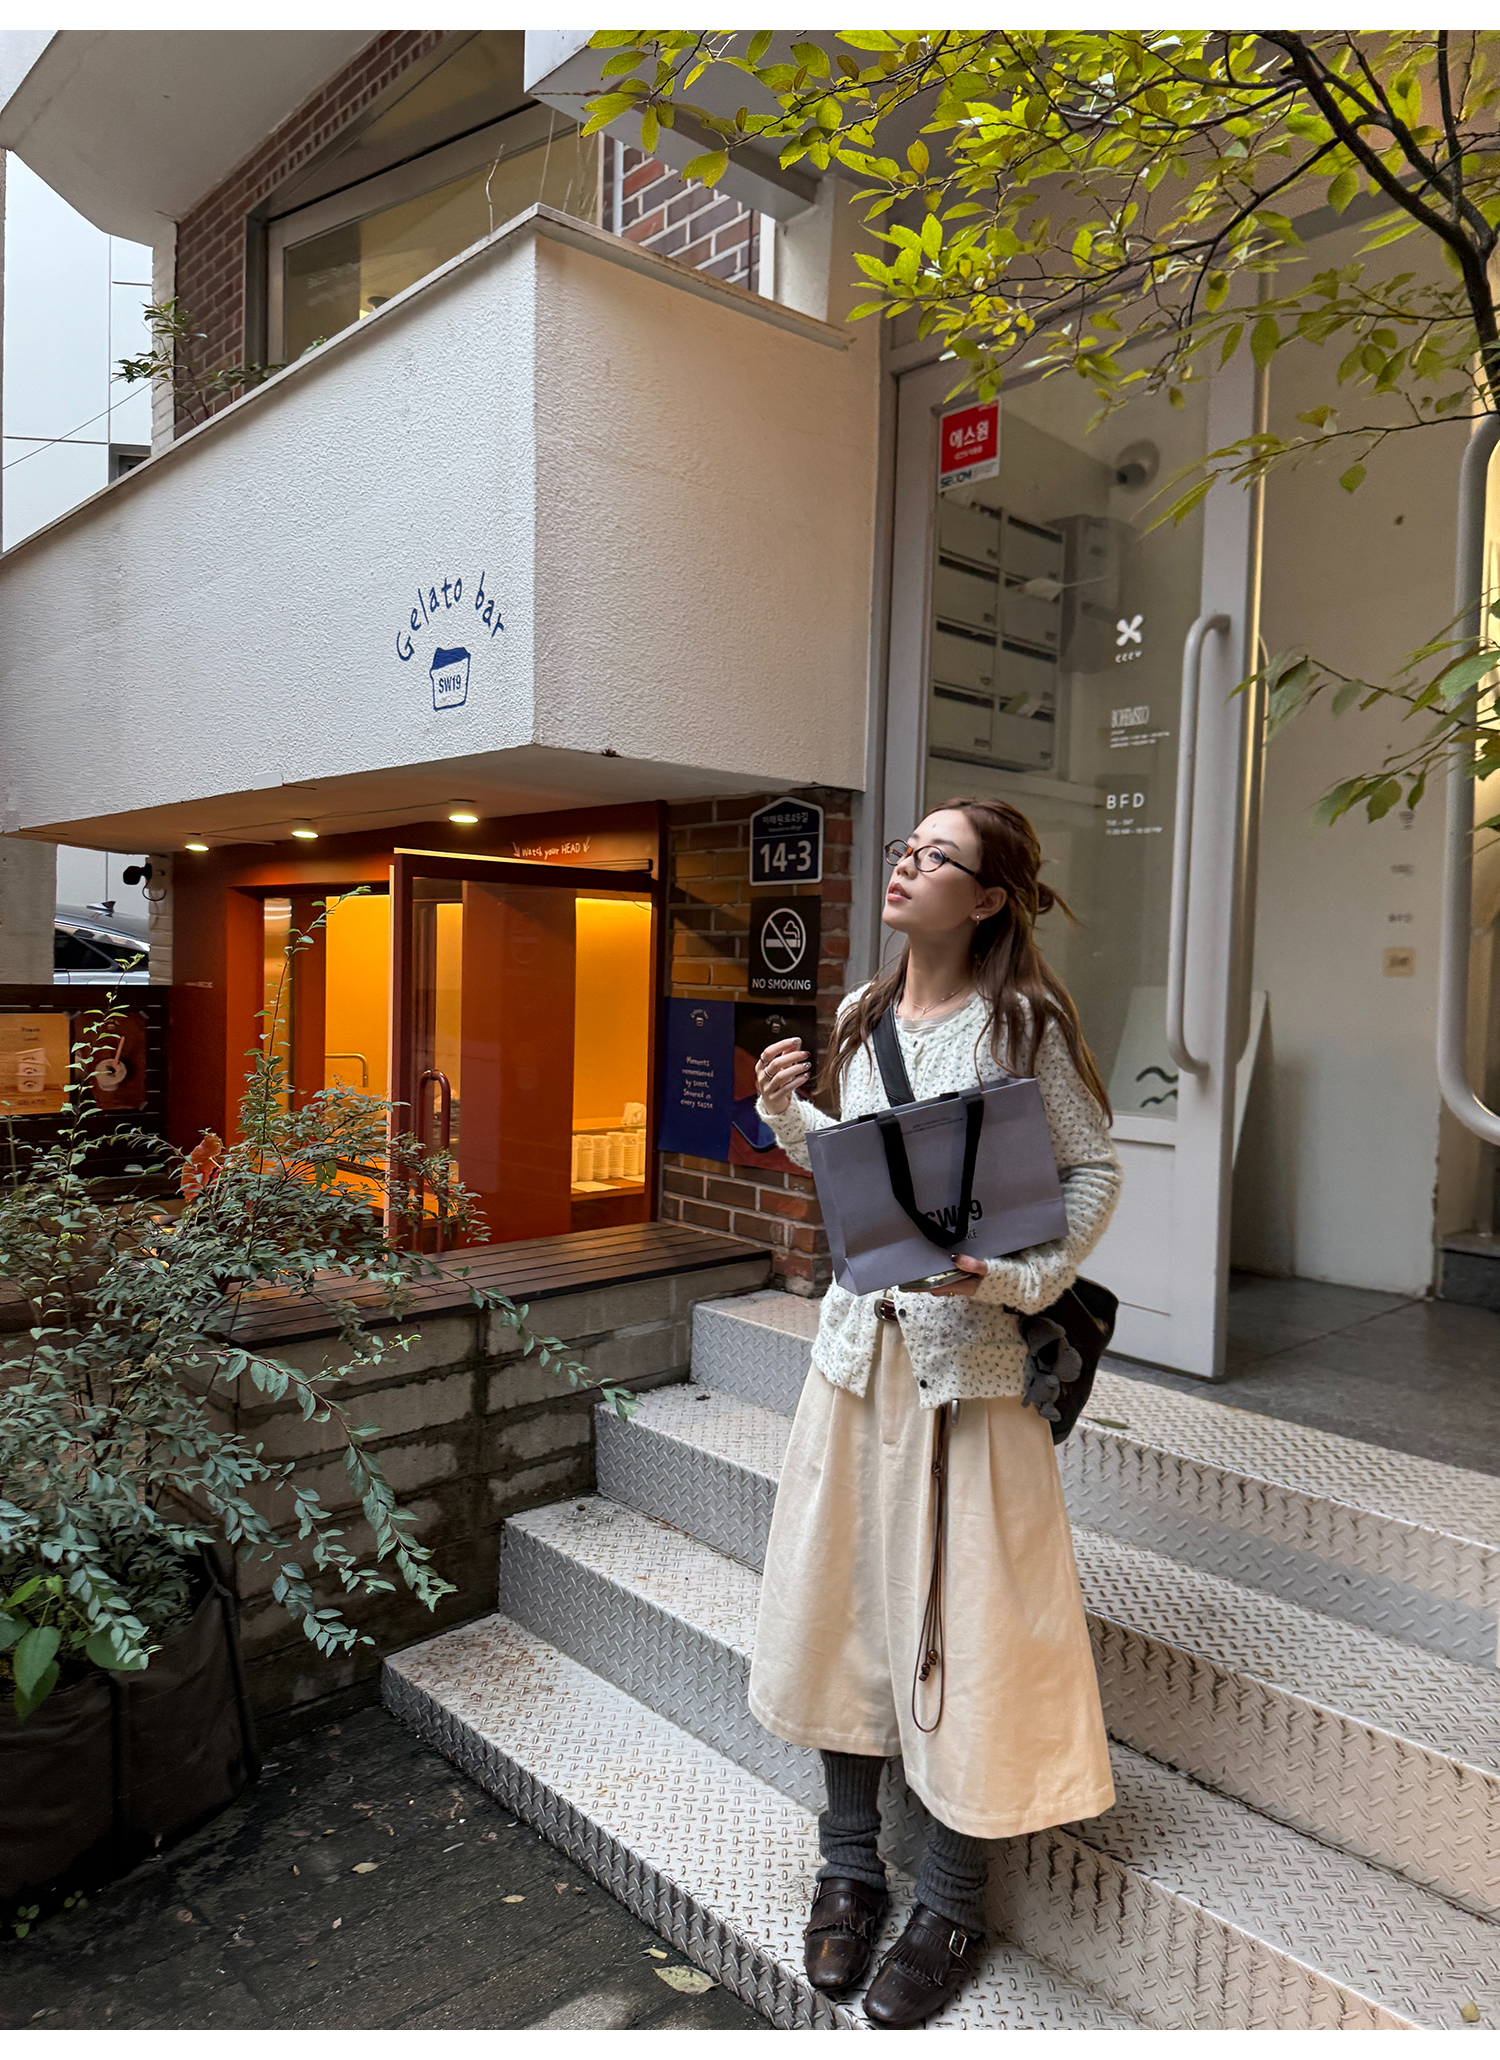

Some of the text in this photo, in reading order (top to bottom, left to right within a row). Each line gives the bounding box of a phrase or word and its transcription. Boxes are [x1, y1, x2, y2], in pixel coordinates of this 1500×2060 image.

[949, 420, 990, 448] 에스원
[396, 570, 505, 661] Gelato bar
[439, 674, 462, 694] SW19
[1106, 792, 1145, 810] BFD
[544, 848, 560, 860] your
[561, 842, 581, 855] HEAD
[760, 840, 812, 874] 14-3
[752, 978, 811, 990] NO SMOKING
[923, 1200, 983, 1229] SW9
